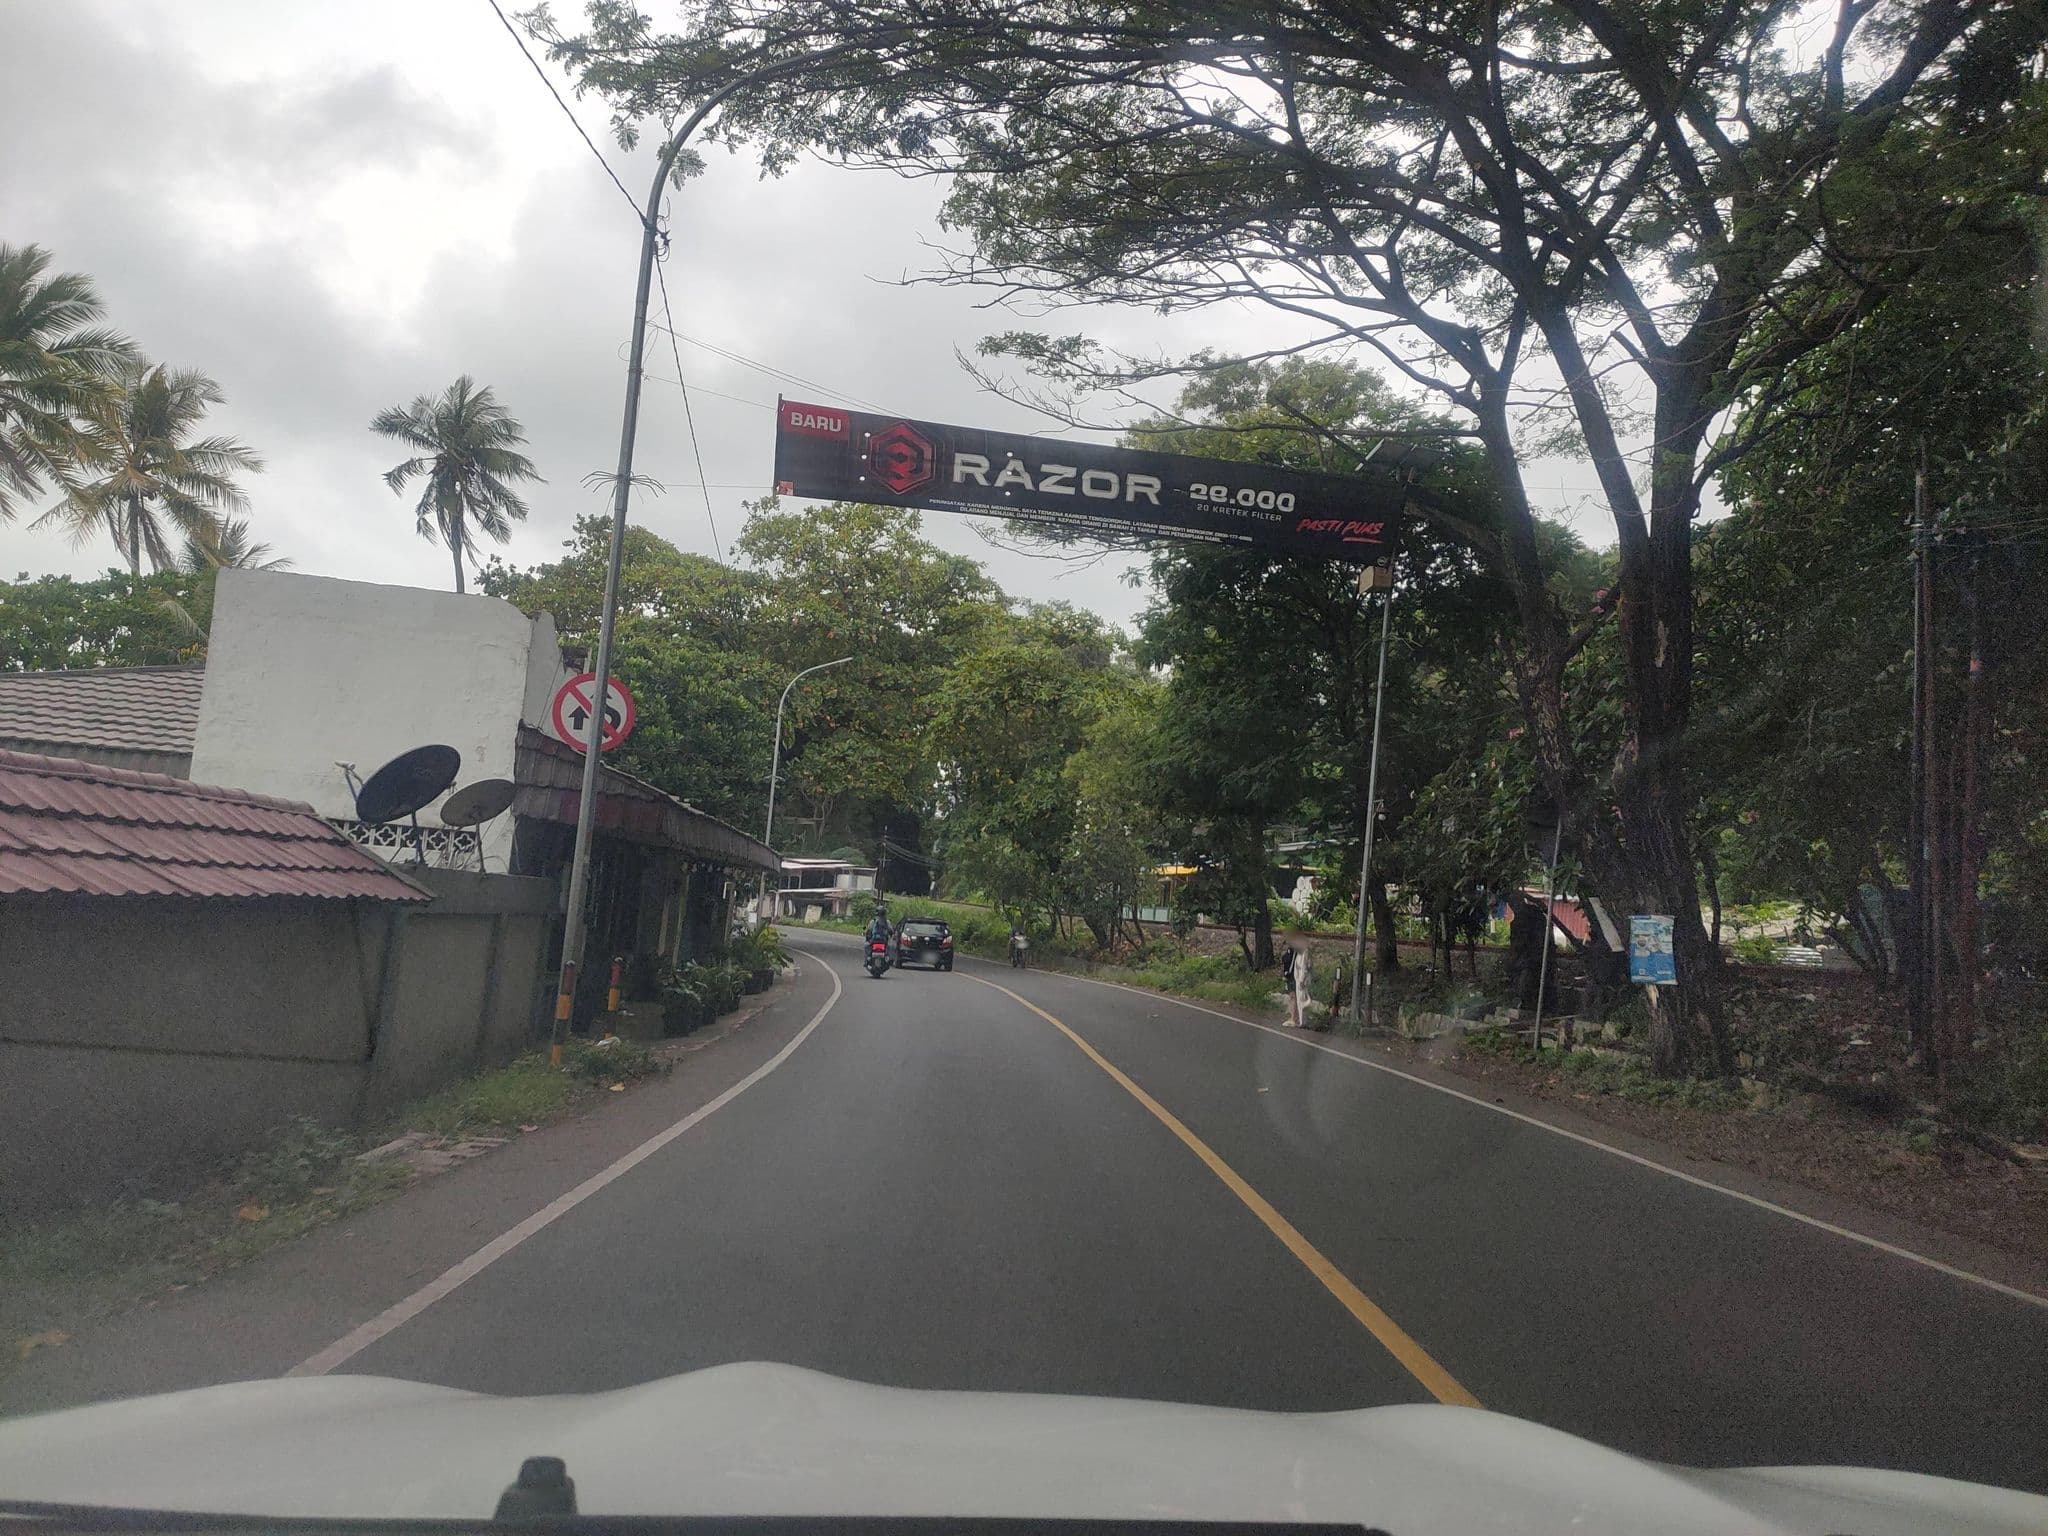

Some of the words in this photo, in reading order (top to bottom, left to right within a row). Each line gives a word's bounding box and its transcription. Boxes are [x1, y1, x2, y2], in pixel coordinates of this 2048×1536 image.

[791, 412, 842, 432] BARU
[952, 452, 1162, 505] RAZOR
[1189, 483, 1296, 513] 28.000
[1197, 503, 1209, 511] 20
[1212, 505, 1249, 518] KRETEK
[1252, 511, 1282, 522] FILTER
[1296, 518, 1343, 533] PASTI
[1341, 521, 1385, 536] PUAS
